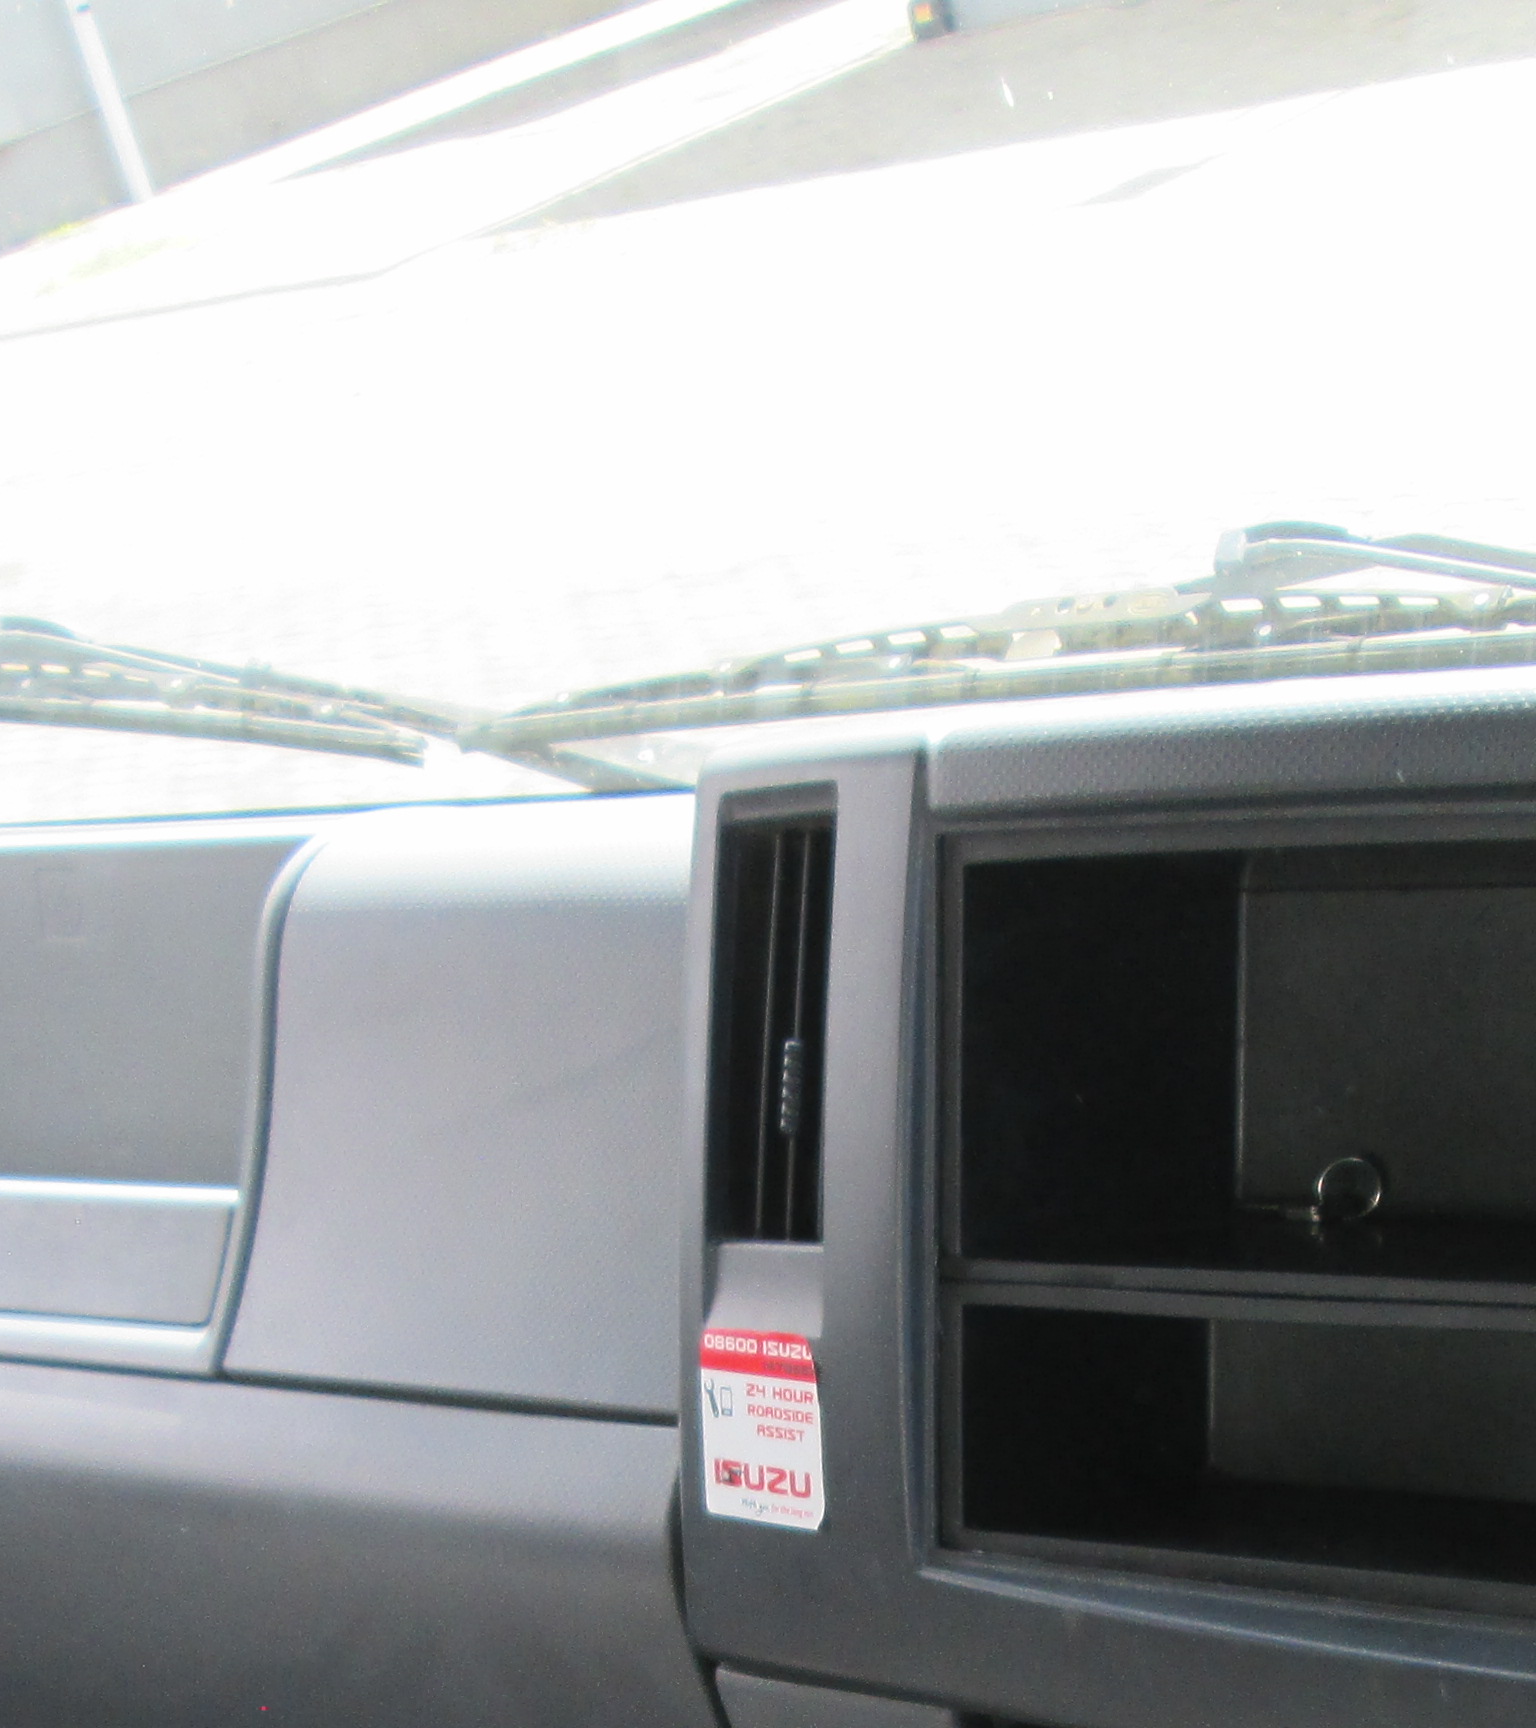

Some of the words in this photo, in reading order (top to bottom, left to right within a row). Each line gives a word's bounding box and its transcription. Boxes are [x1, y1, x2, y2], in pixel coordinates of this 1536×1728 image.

[704, 1334, 758, 1354] 08600
[762, 1340, 813, 1361] ISUZU
[746, 1383, 766, 1398] 24
[773, 1387, 814, 1404] HOUR
[747, 1404, 814, 1424] ROADSIDE
[756, 1424, 805, 1442] ASSIST
[714, 1458, 811, 1498] ISUZU
